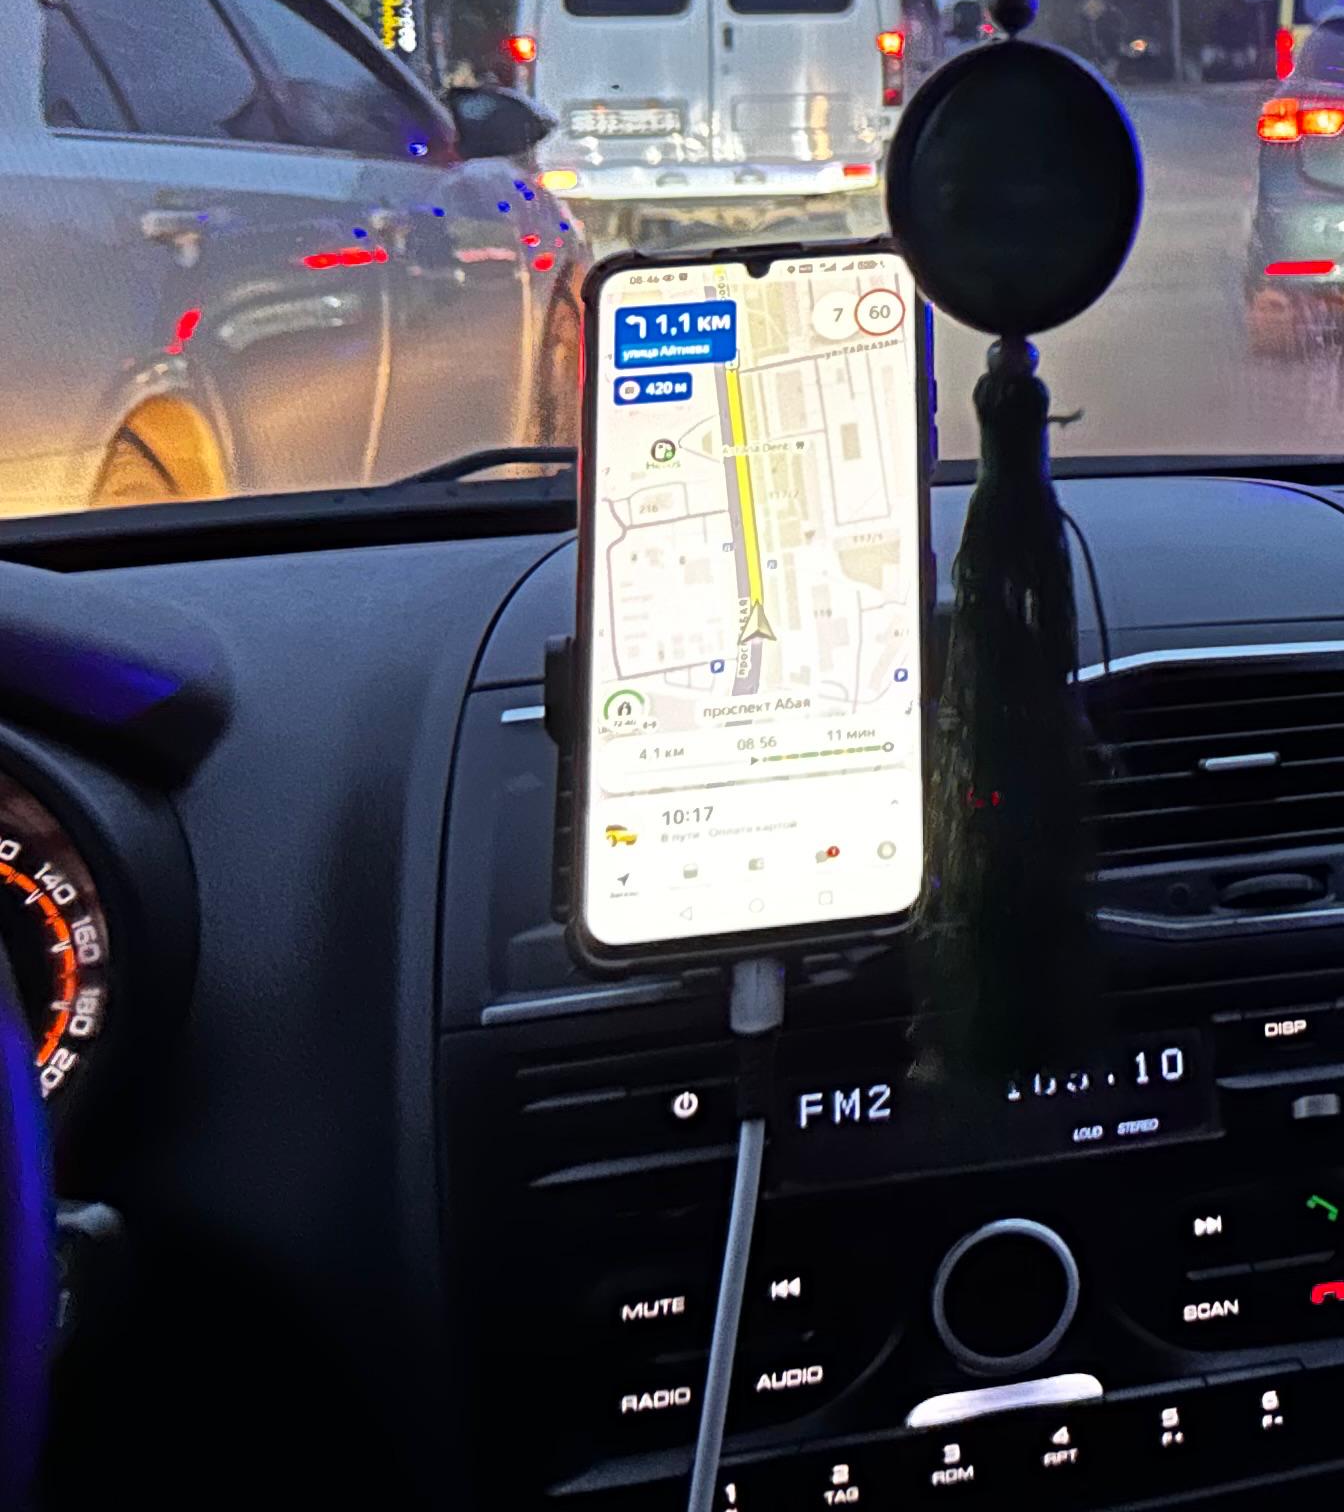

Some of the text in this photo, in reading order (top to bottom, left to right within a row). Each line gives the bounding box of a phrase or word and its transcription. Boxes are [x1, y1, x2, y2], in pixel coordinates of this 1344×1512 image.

[832, 307, 844, 322] 7
[868, 304, 891, 319] 60
[655, 312, 731, 336] 1,1 км
[645, 381, 673, 395] 420
[703, 697, 811, 719] проспект Абая
[827, 729, 842, 741] 11
[661, 806, 715, 826] 10:17
[34, 861, 78, 907] 140
[71, 915, 103, 965] 160
[1264, 1018, 1308, 1038] DISP
[798, 1083, 892, 1129] FM2
[621, 1294, 686, 1322] MUTE
[1183, 1298, 1240, 1322] SCAN
[755, 1364, 824, 1393] AUDIO
[620, 1385, 692, 1415] RADIO
[1051, 1425, 1070, 1446] 4
[724, 1482, 737, 1504] 1
[823, 1484, 860, 1506] TAG
